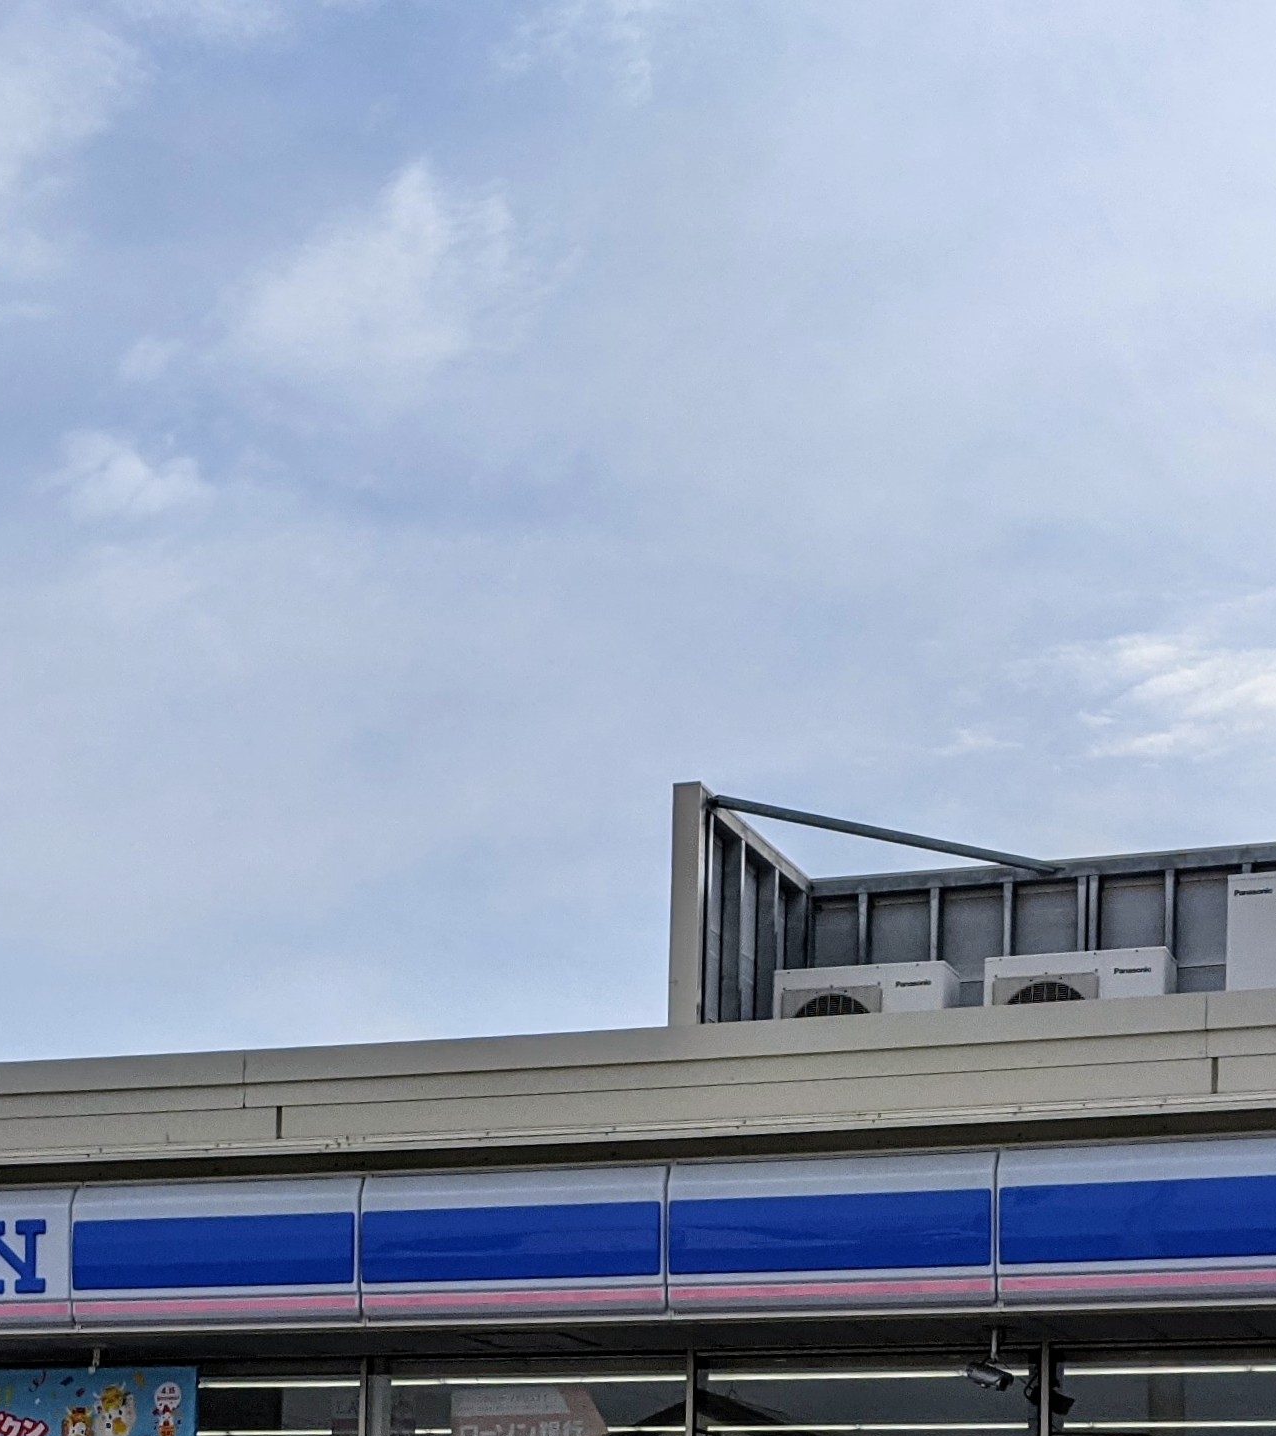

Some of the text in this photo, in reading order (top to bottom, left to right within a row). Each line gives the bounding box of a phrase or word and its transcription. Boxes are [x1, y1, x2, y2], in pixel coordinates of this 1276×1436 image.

[1234, 888, 1273, 896] Panasonic
[1113, 966, 1152, 974] Panasonic
[895, 980, 932, 988] Panasonic
